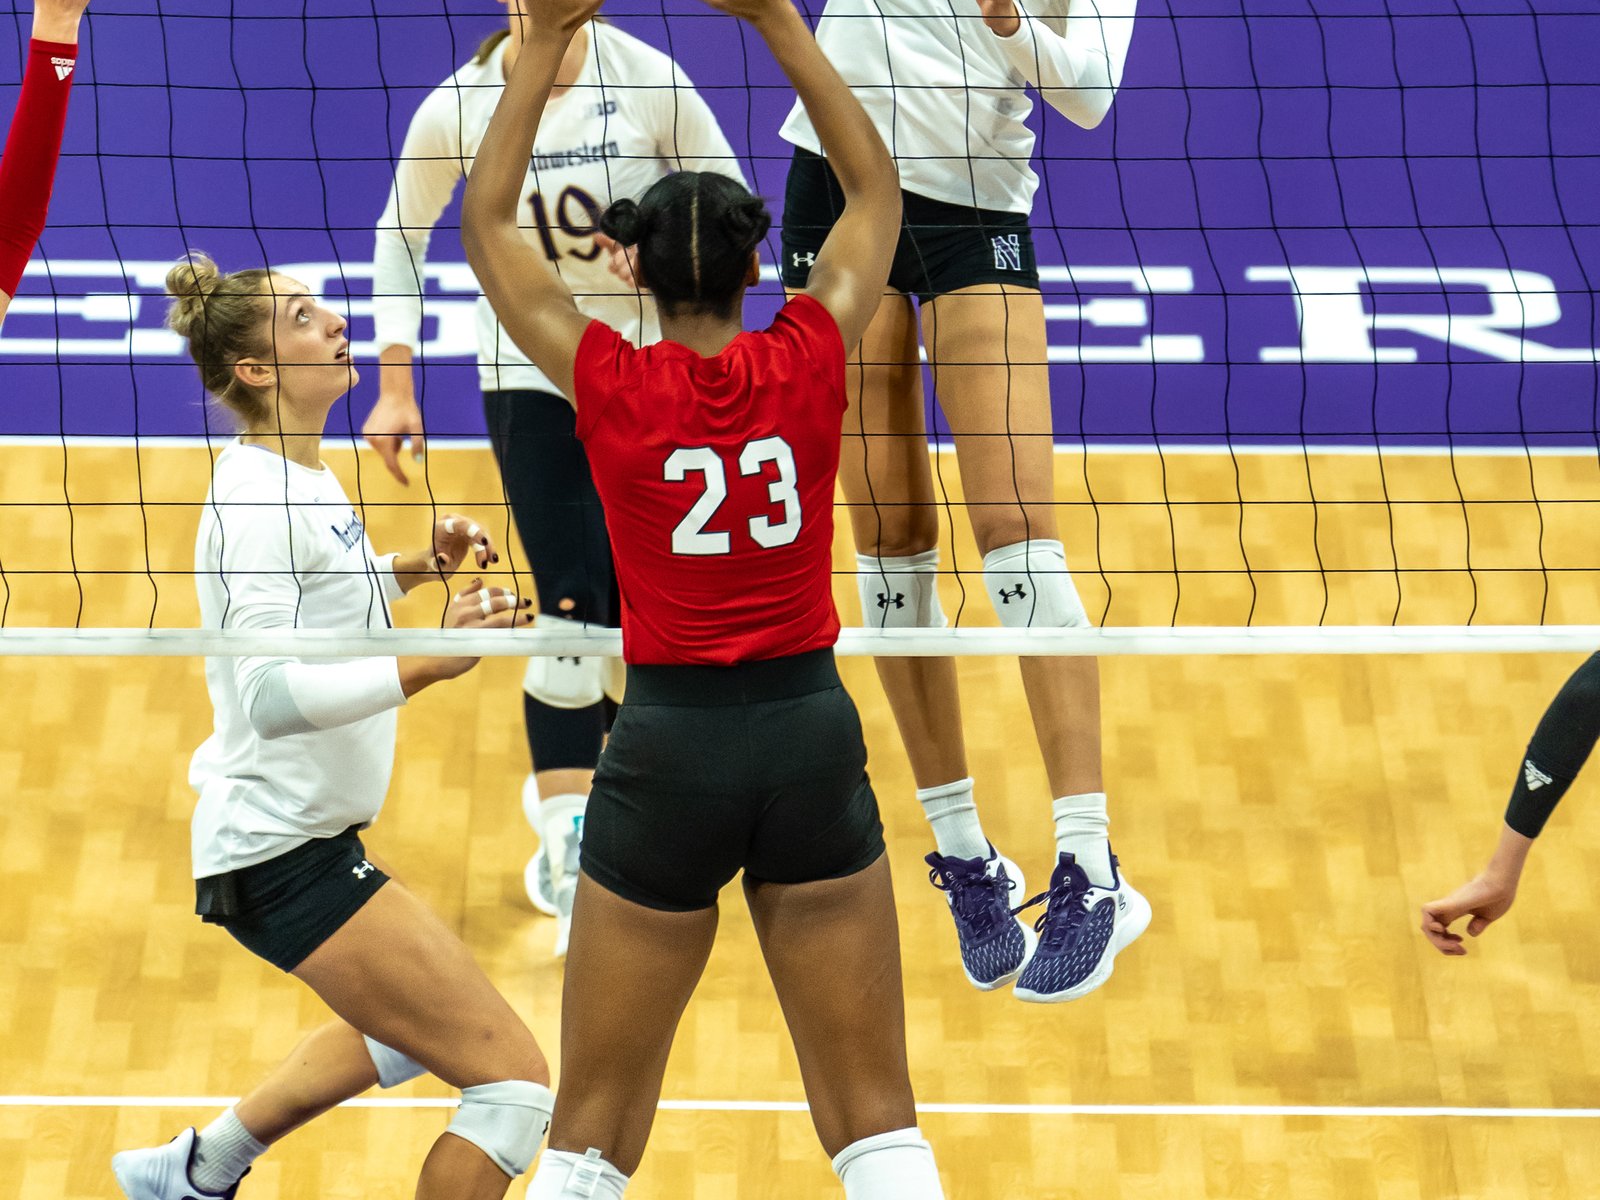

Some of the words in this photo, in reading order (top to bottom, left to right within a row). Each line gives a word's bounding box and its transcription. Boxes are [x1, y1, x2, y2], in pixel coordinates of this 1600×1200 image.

[527, 184, 603, 260] 19
[991, 234, 1021, 270] N
[663, 435, 802, 556] 23
